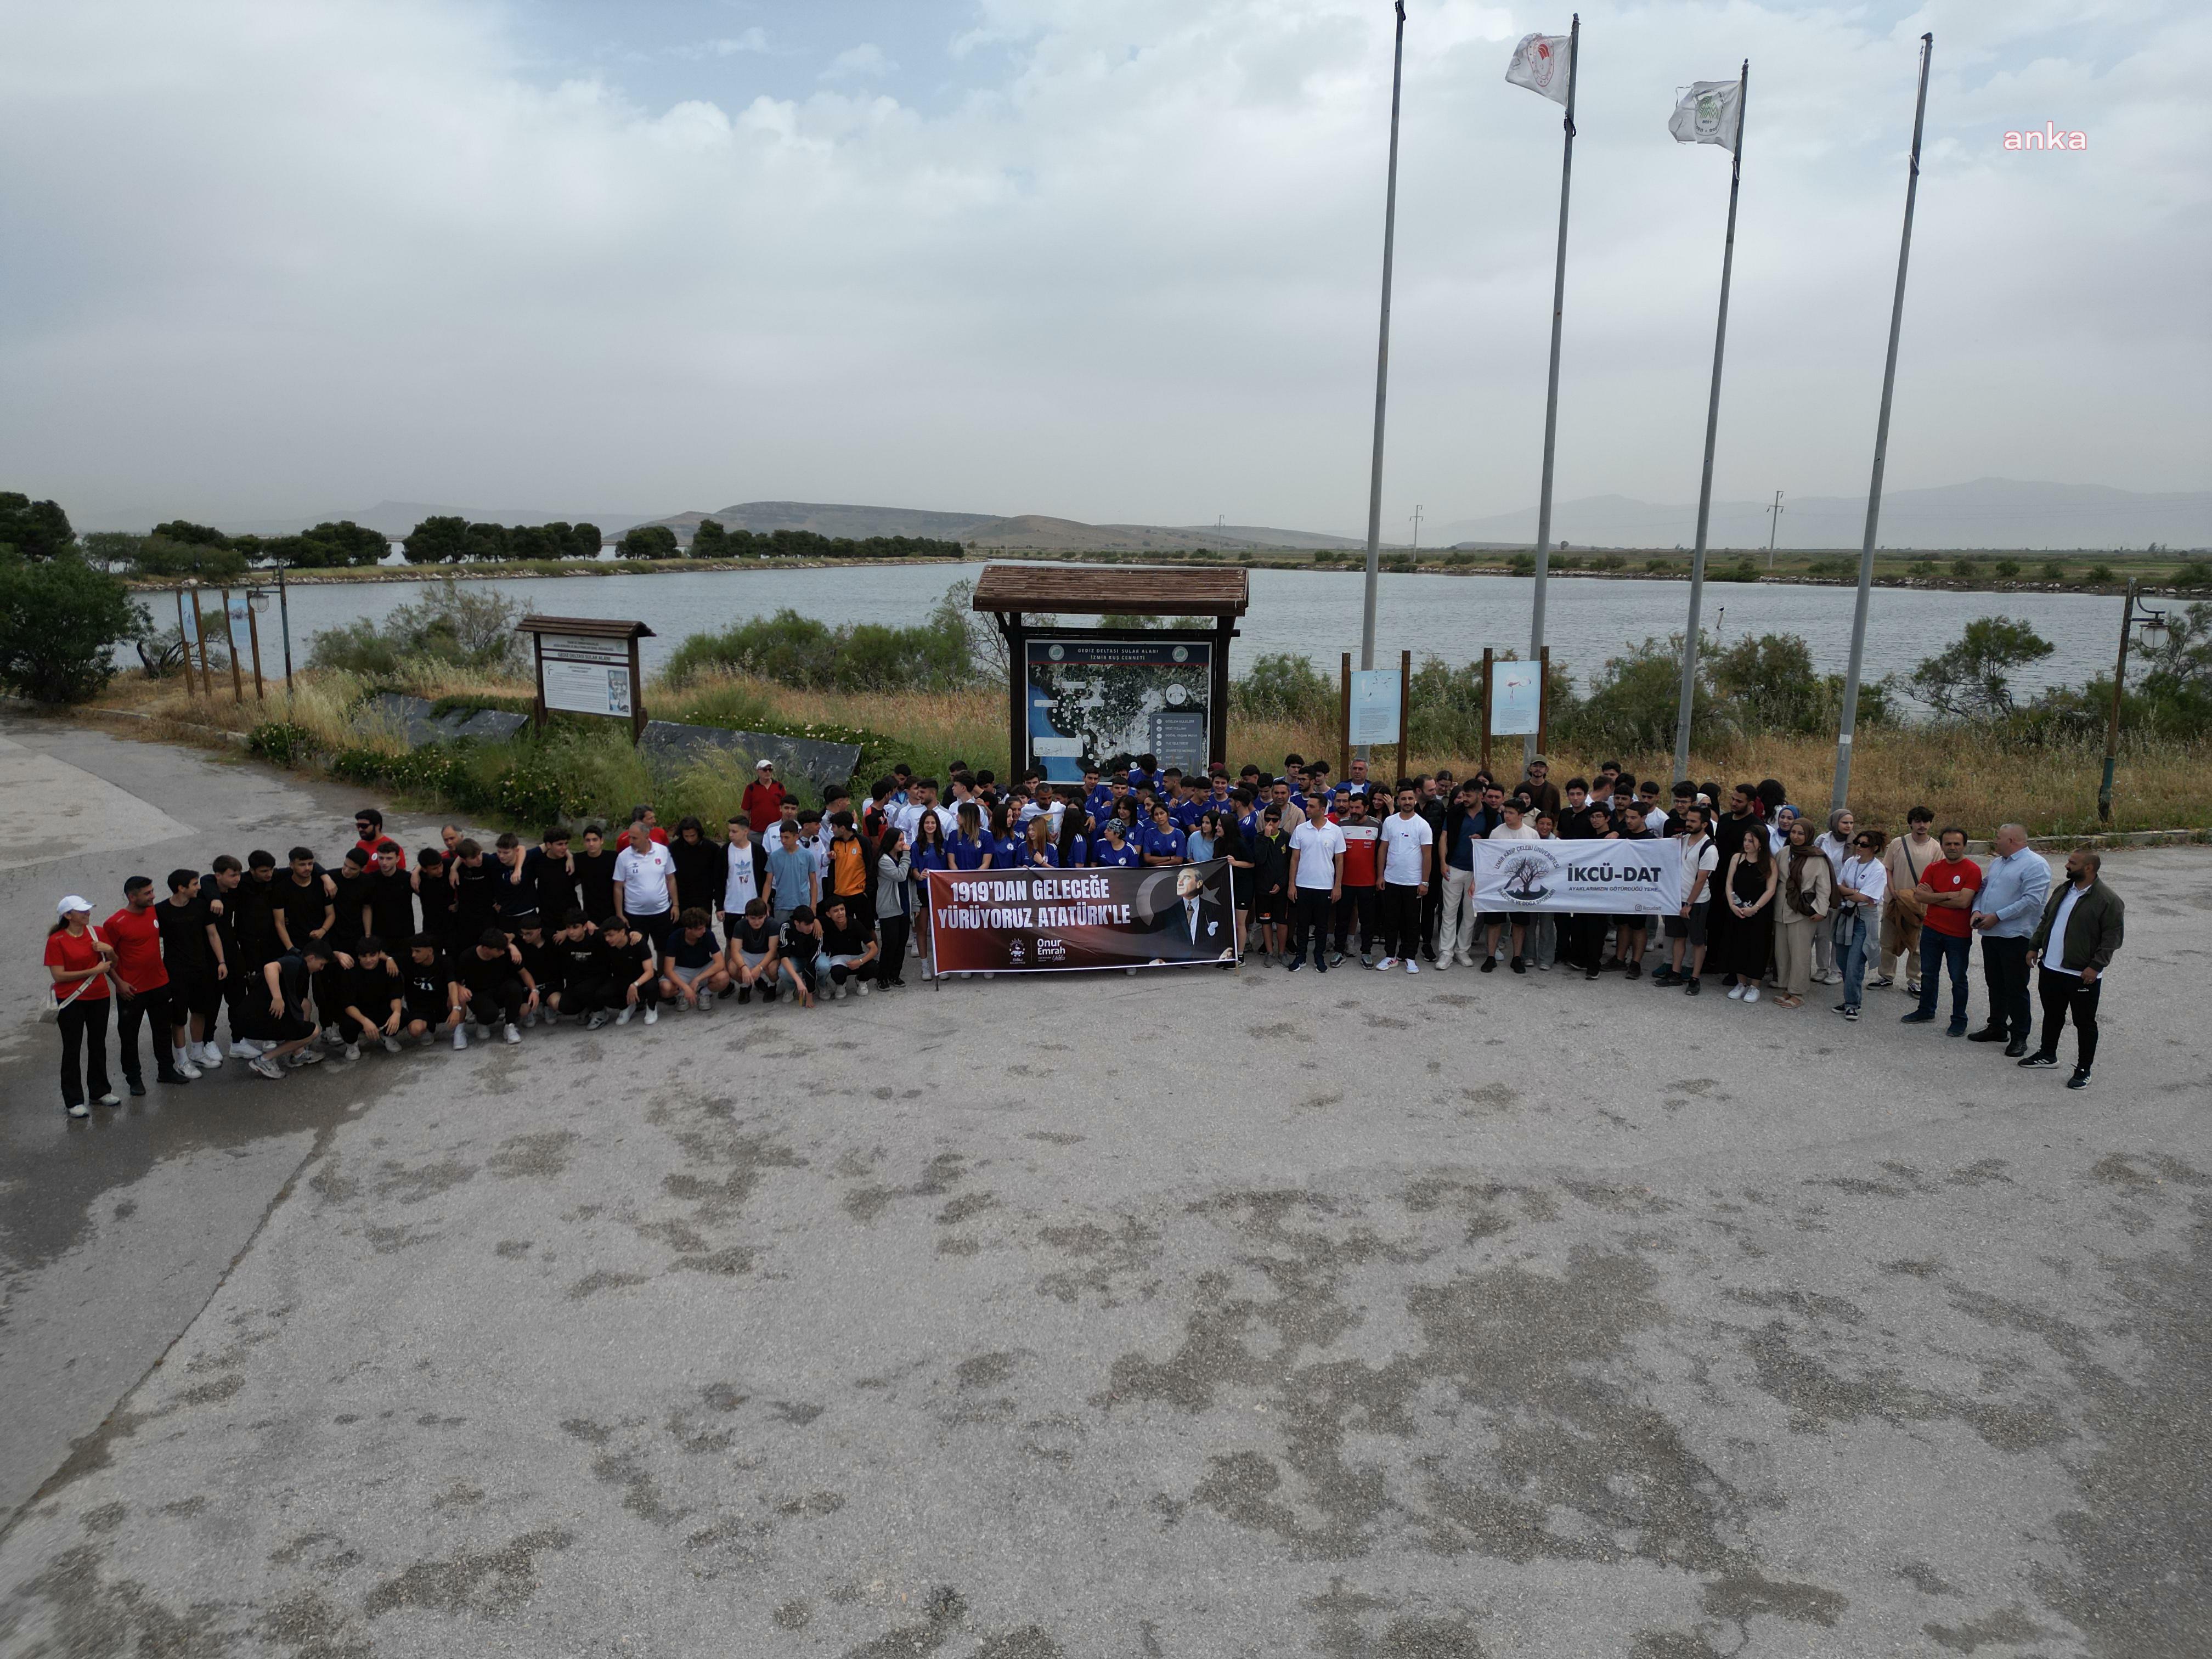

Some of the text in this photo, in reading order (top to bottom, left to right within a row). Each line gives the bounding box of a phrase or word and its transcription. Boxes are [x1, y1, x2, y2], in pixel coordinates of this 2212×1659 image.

[1567, 862, 1662, 882] İKCÜ-DAT
[950, 874, 1110, 902] 1919'DAN GELECEĞE
[938, 901, 1131, 929] YÜRÜYORUZ ATATÜRK'LE
[1037, 938, 1062, 947] Onur
[1037, 946, 1065, 955] Emrah
